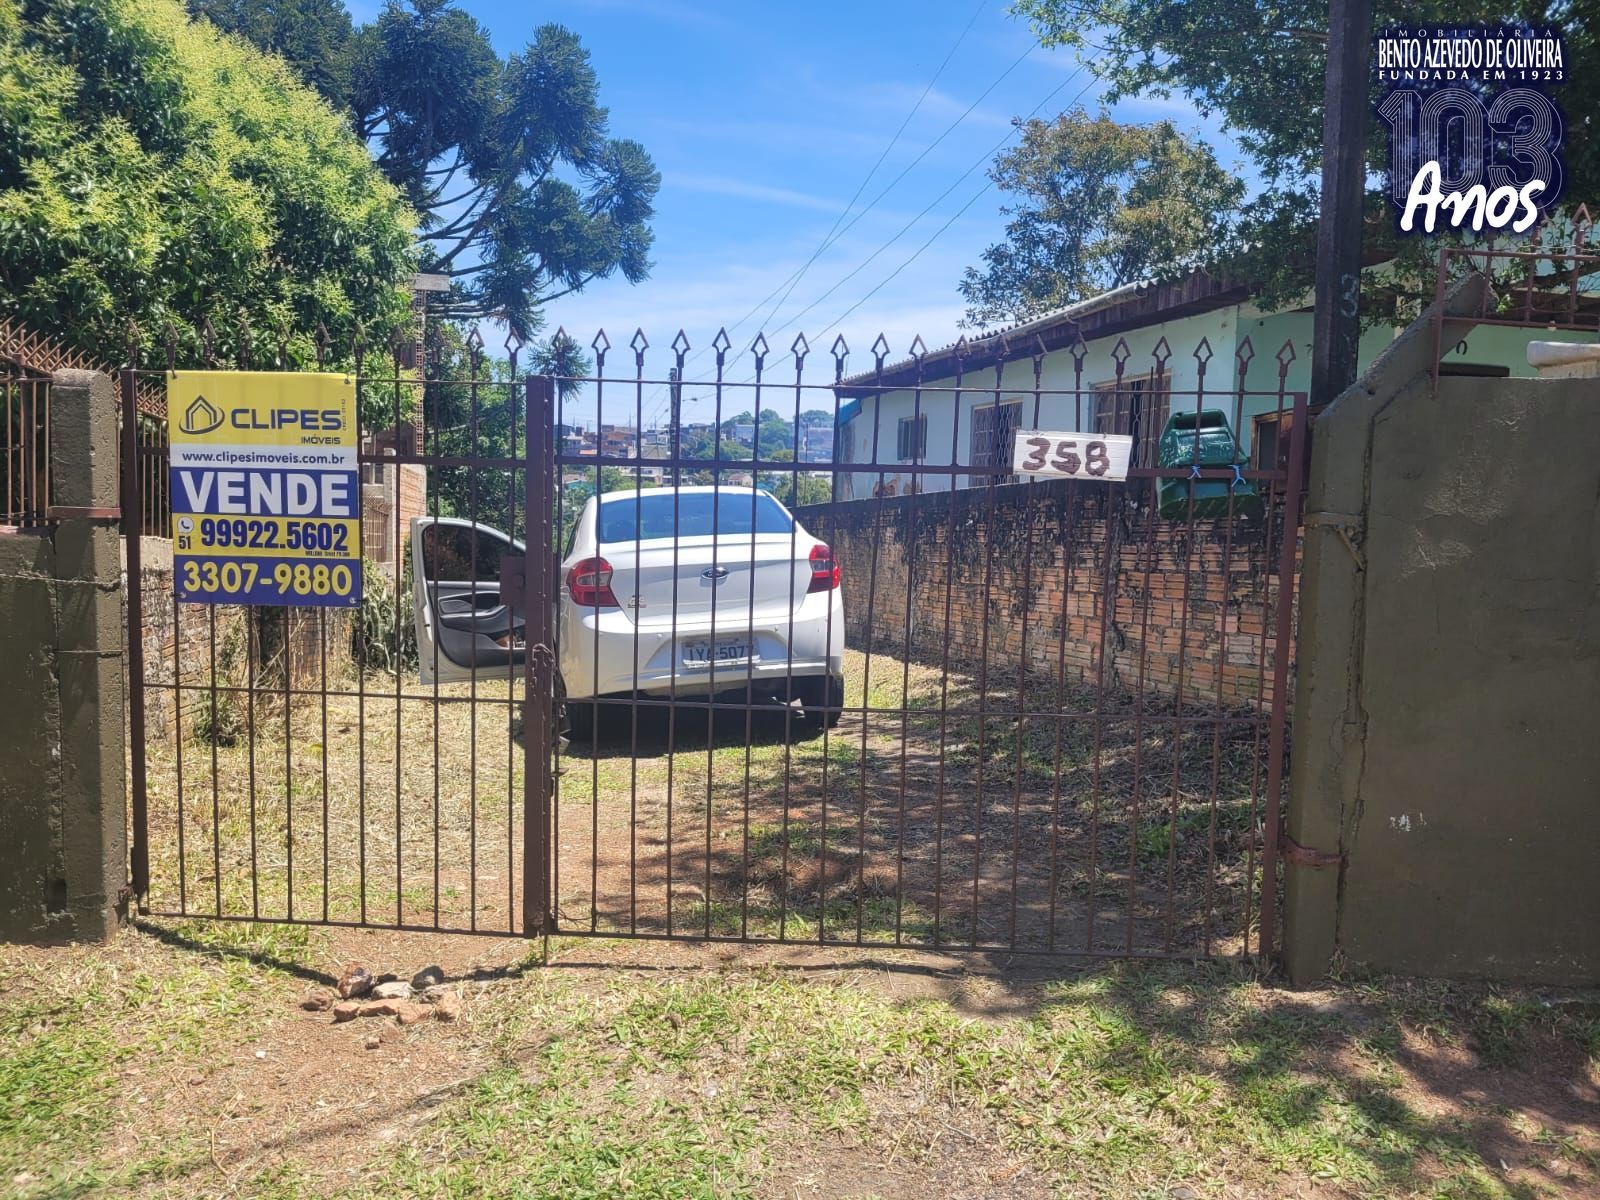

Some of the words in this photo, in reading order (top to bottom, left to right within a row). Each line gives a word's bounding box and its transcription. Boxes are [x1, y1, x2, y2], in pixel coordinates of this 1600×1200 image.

[230, 408, 342, 431] CLIPES
[300, 434, 341, 445] IMÓVEIS
[182, 451, 345, 465] www.clipesimoveis.com.br
[1021, 437, 1111, 476] 358
[179, 470, 350, 517] VENDE
[178, 535, 192, 550] 51
[200, 518, 348, 551] 99922.5602
[182, 560, 353, 597] 3307-9880
